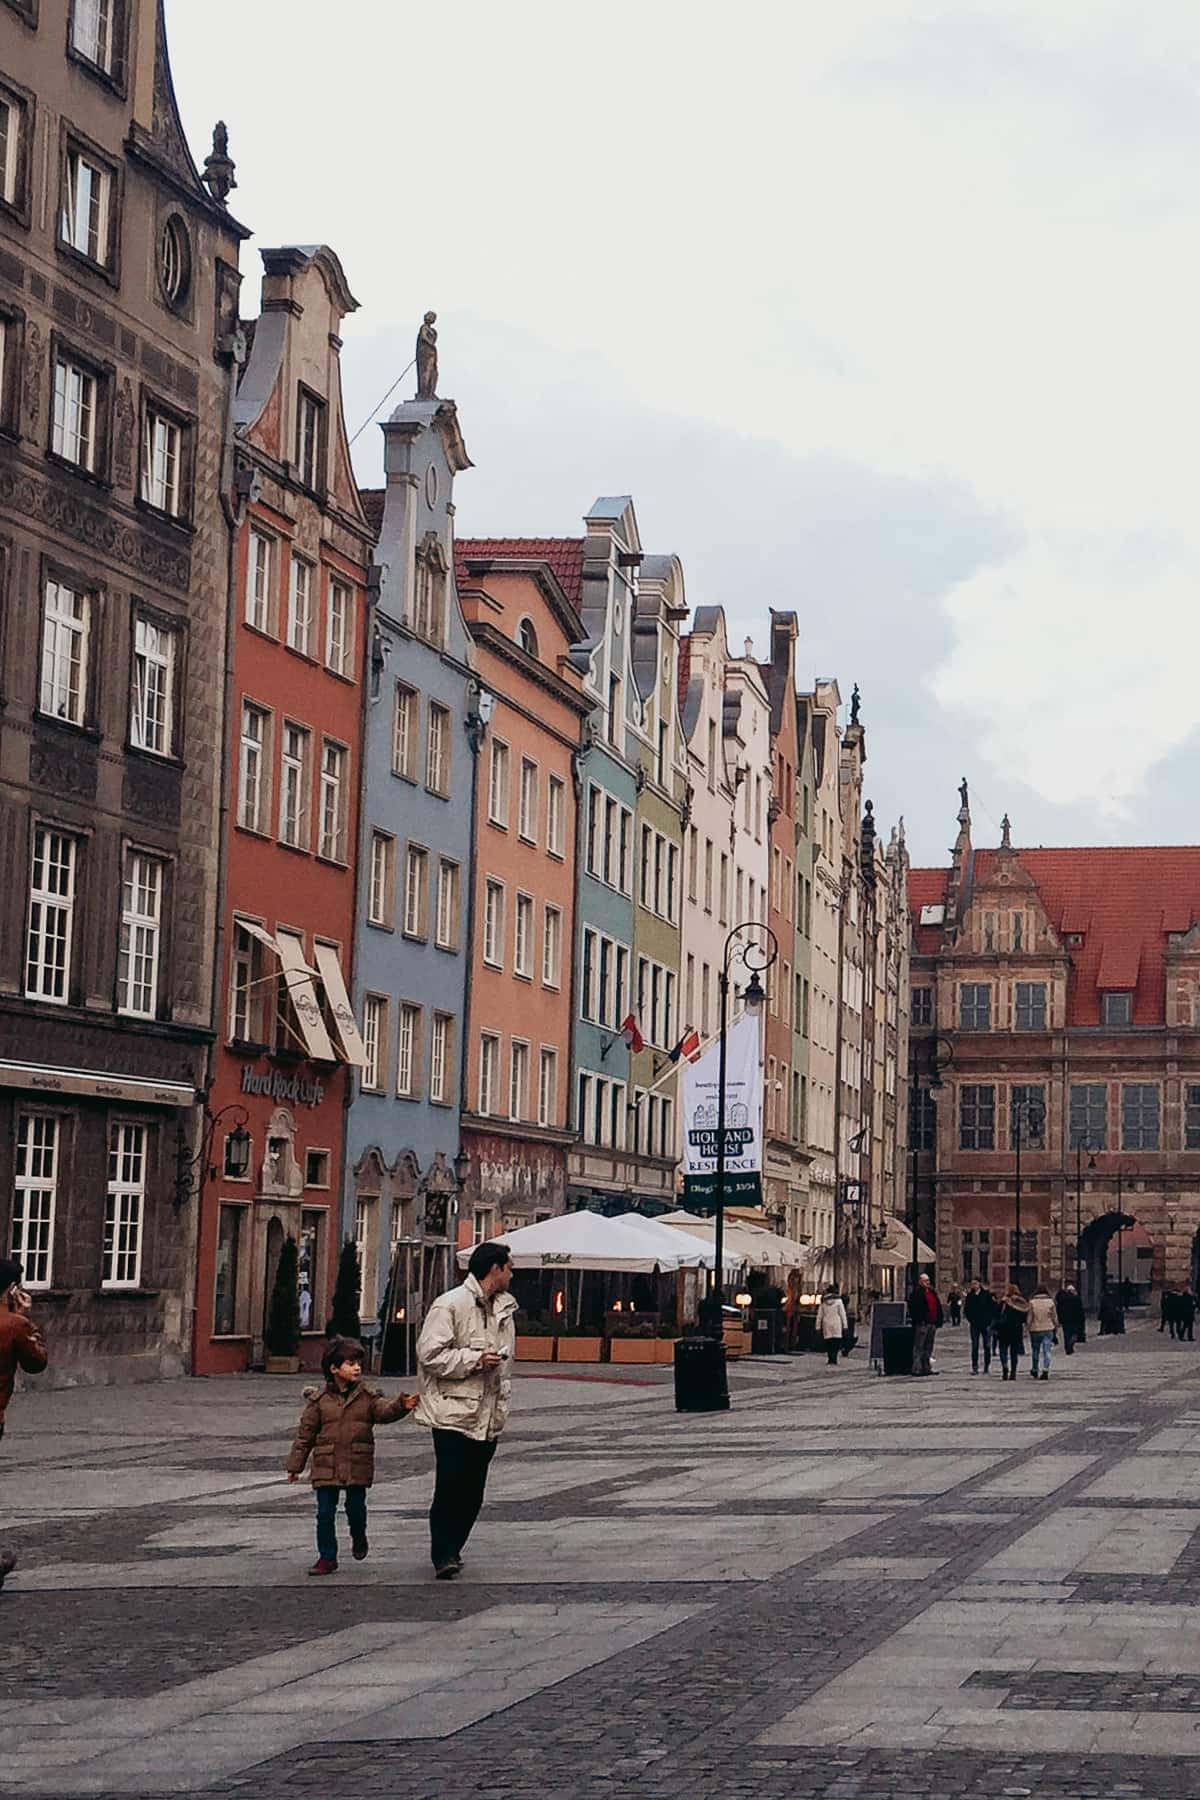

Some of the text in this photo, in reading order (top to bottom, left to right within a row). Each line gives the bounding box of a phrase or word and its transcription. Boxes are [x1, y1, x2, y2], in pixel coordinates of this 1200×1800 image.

[242, 1064, 273, 1095] Hard
[691, 1130, 752, 1144] HOLAND
[702, 1142, 740, 1155] HOSE
[689, 1160, 757, 1170] RESIENCE
